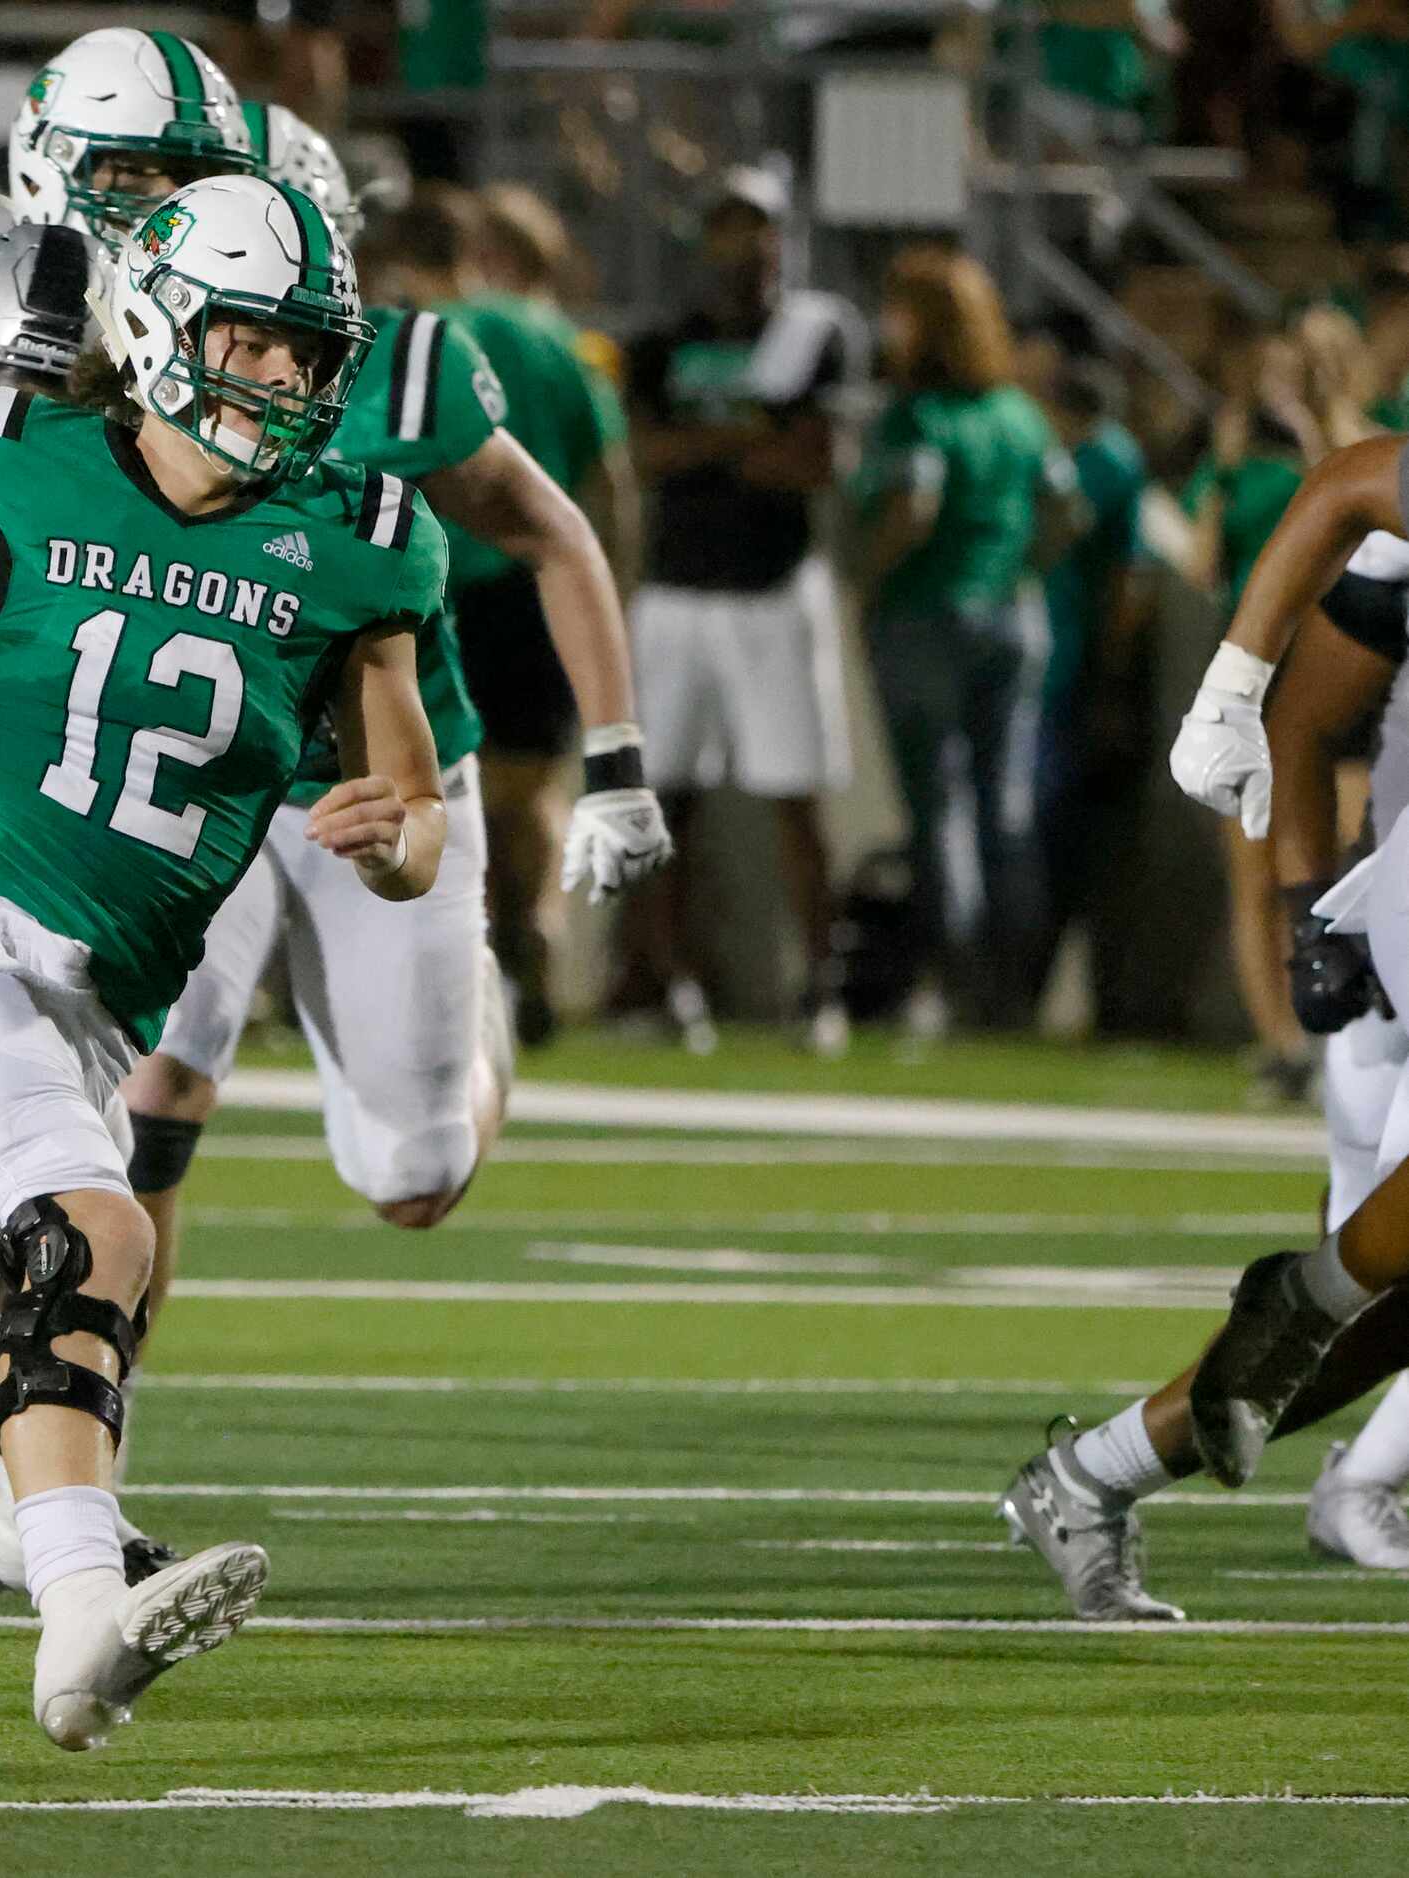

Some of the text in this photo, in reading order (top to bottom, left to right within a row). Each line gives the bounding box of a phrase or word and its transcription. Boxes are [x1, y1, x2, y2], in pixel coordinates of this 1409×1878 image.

[46, 539, 300, 637] DRAGONS
[262, 542, 314, 571] adidas
[39, 609, 244, 861] 12
